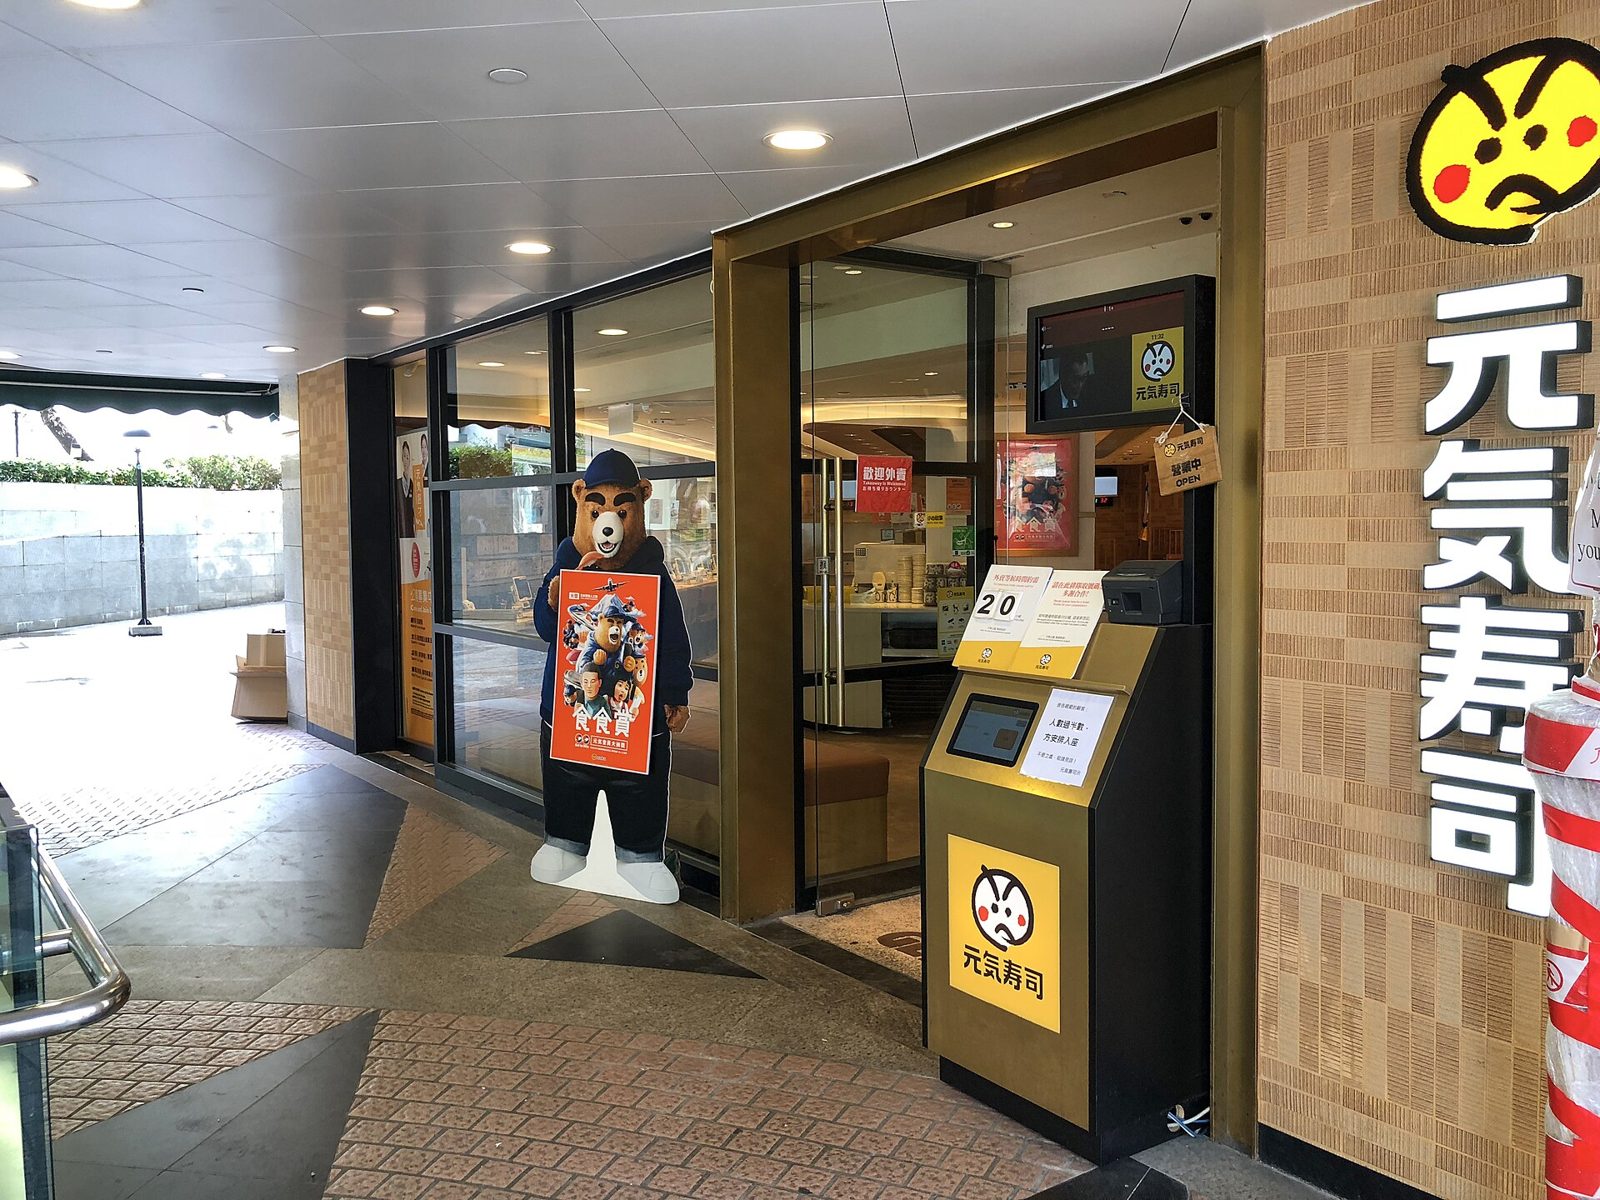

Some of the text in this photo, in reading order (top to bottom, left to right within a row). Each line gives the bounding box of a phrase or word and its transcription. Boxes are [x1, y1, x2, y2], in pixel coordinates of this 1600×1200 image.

[1136, 383, 1180, 401] 元気寿司
[863, 466, 907, 481] 歡迎外賣
[1175, 474, 1201, 487] OPEN
[977, 594, 1015, 616] 20
[572, 703, 632, 738] 食食賞
[963, 943, 1044, 1001] 元気寿司
